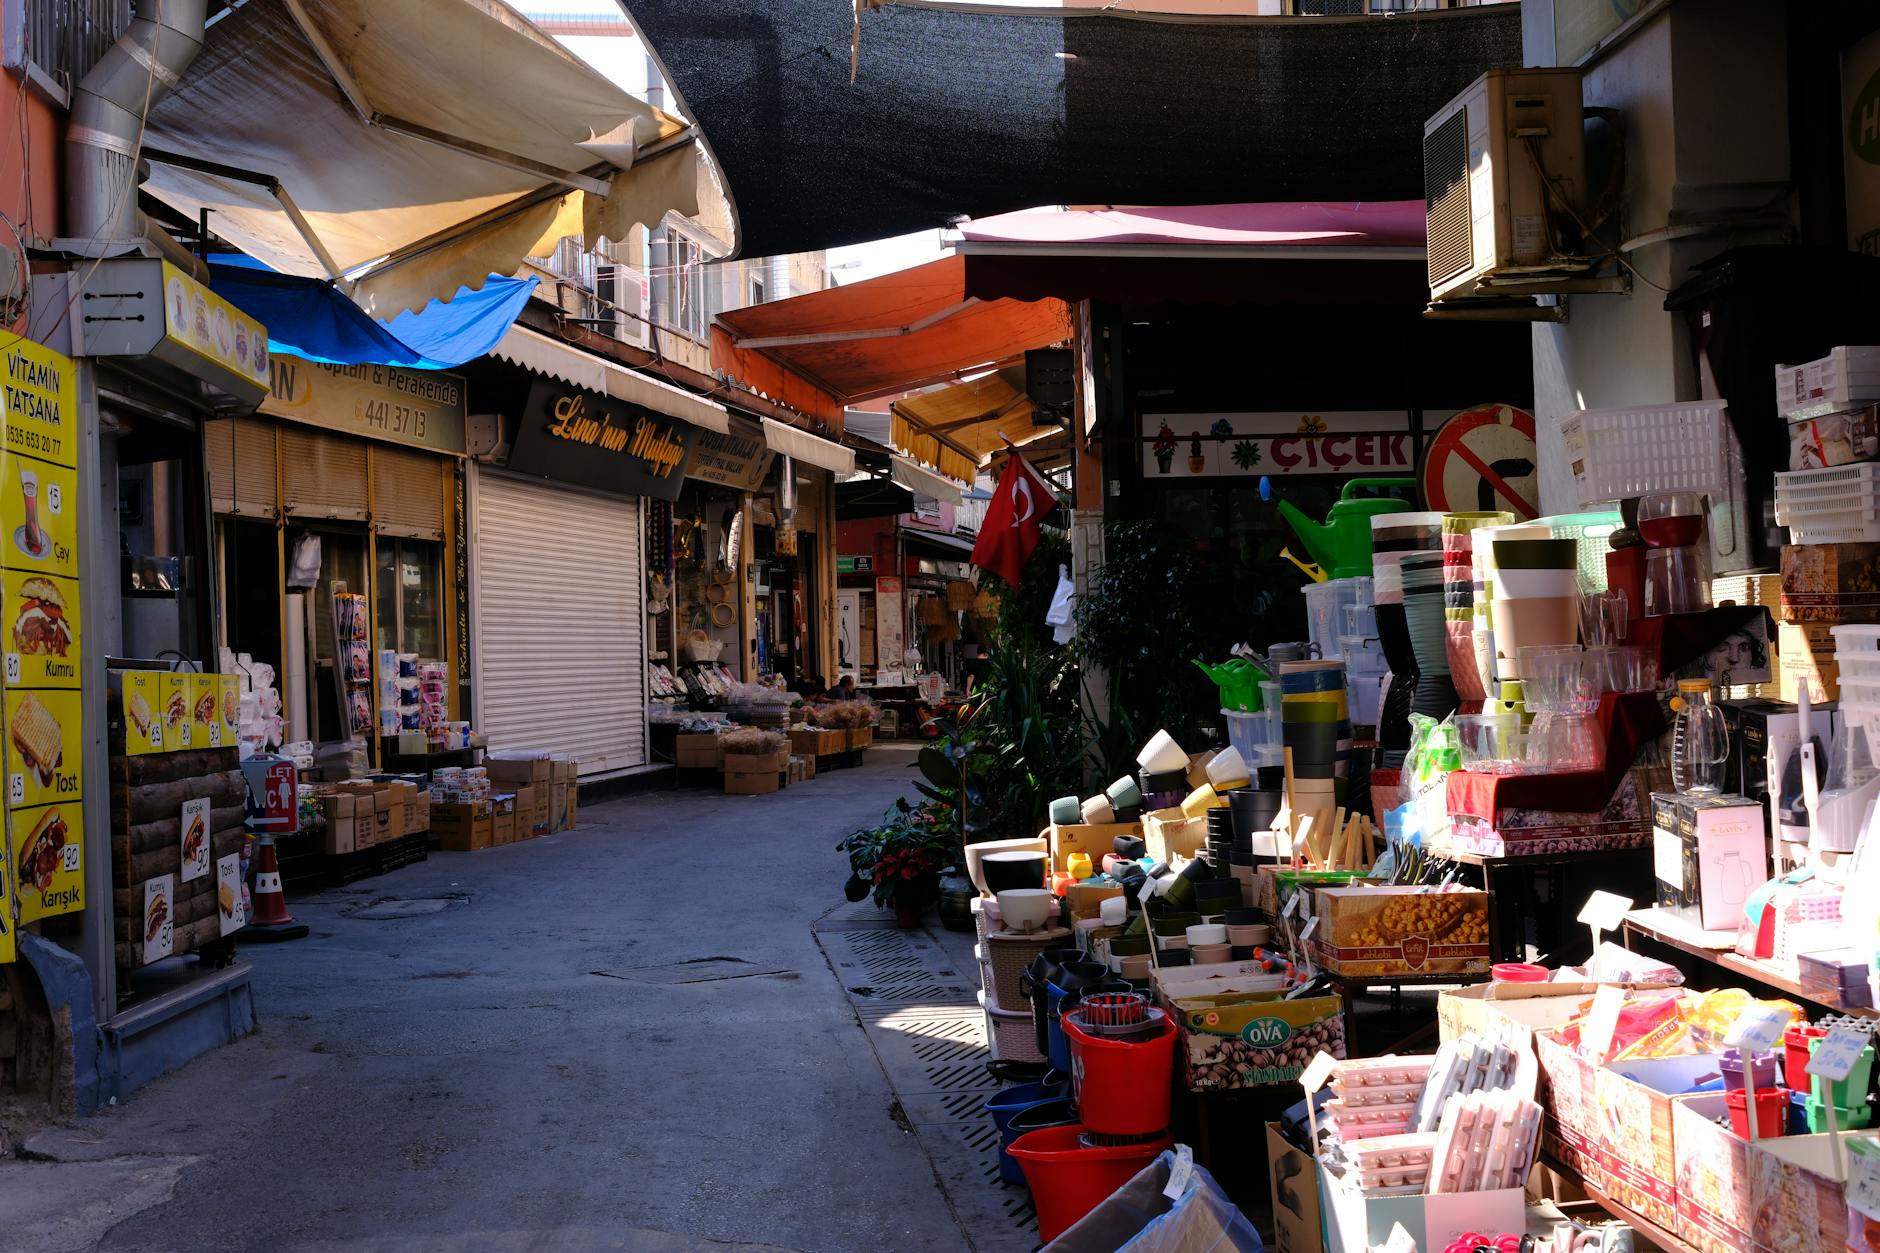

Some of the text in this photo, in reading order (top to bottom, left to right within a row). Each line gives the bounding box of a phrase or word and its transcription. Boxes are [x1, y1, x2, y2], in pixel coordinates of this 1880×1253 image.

[7, 348, 60, 394] VİTAMİN
[387, 367, 458, 406] Perakende
[5, 384, 61, 427] TATSANA
[365, 399, 427, 439] 441 37 13
[6, 424, 61, 456] 0535 653 20 77
[54, 542, 70, 564] Çay
[7, 657, 19, 677] 80
[45, 660, 75, 678] Kumru
[55, 772, 78, 793] Tost
[64, 846, 78, 869] 90
[197, 847, 208, 872] 90
[220, 863, 234, 877] Tost
[41, 885, 80, 909] Karışık
[1356, 949, 1393, 959] Leblebi
[1438, 946, 1473, 957] Leblebi
[1249, 1026, 1283, 1042] OVA
